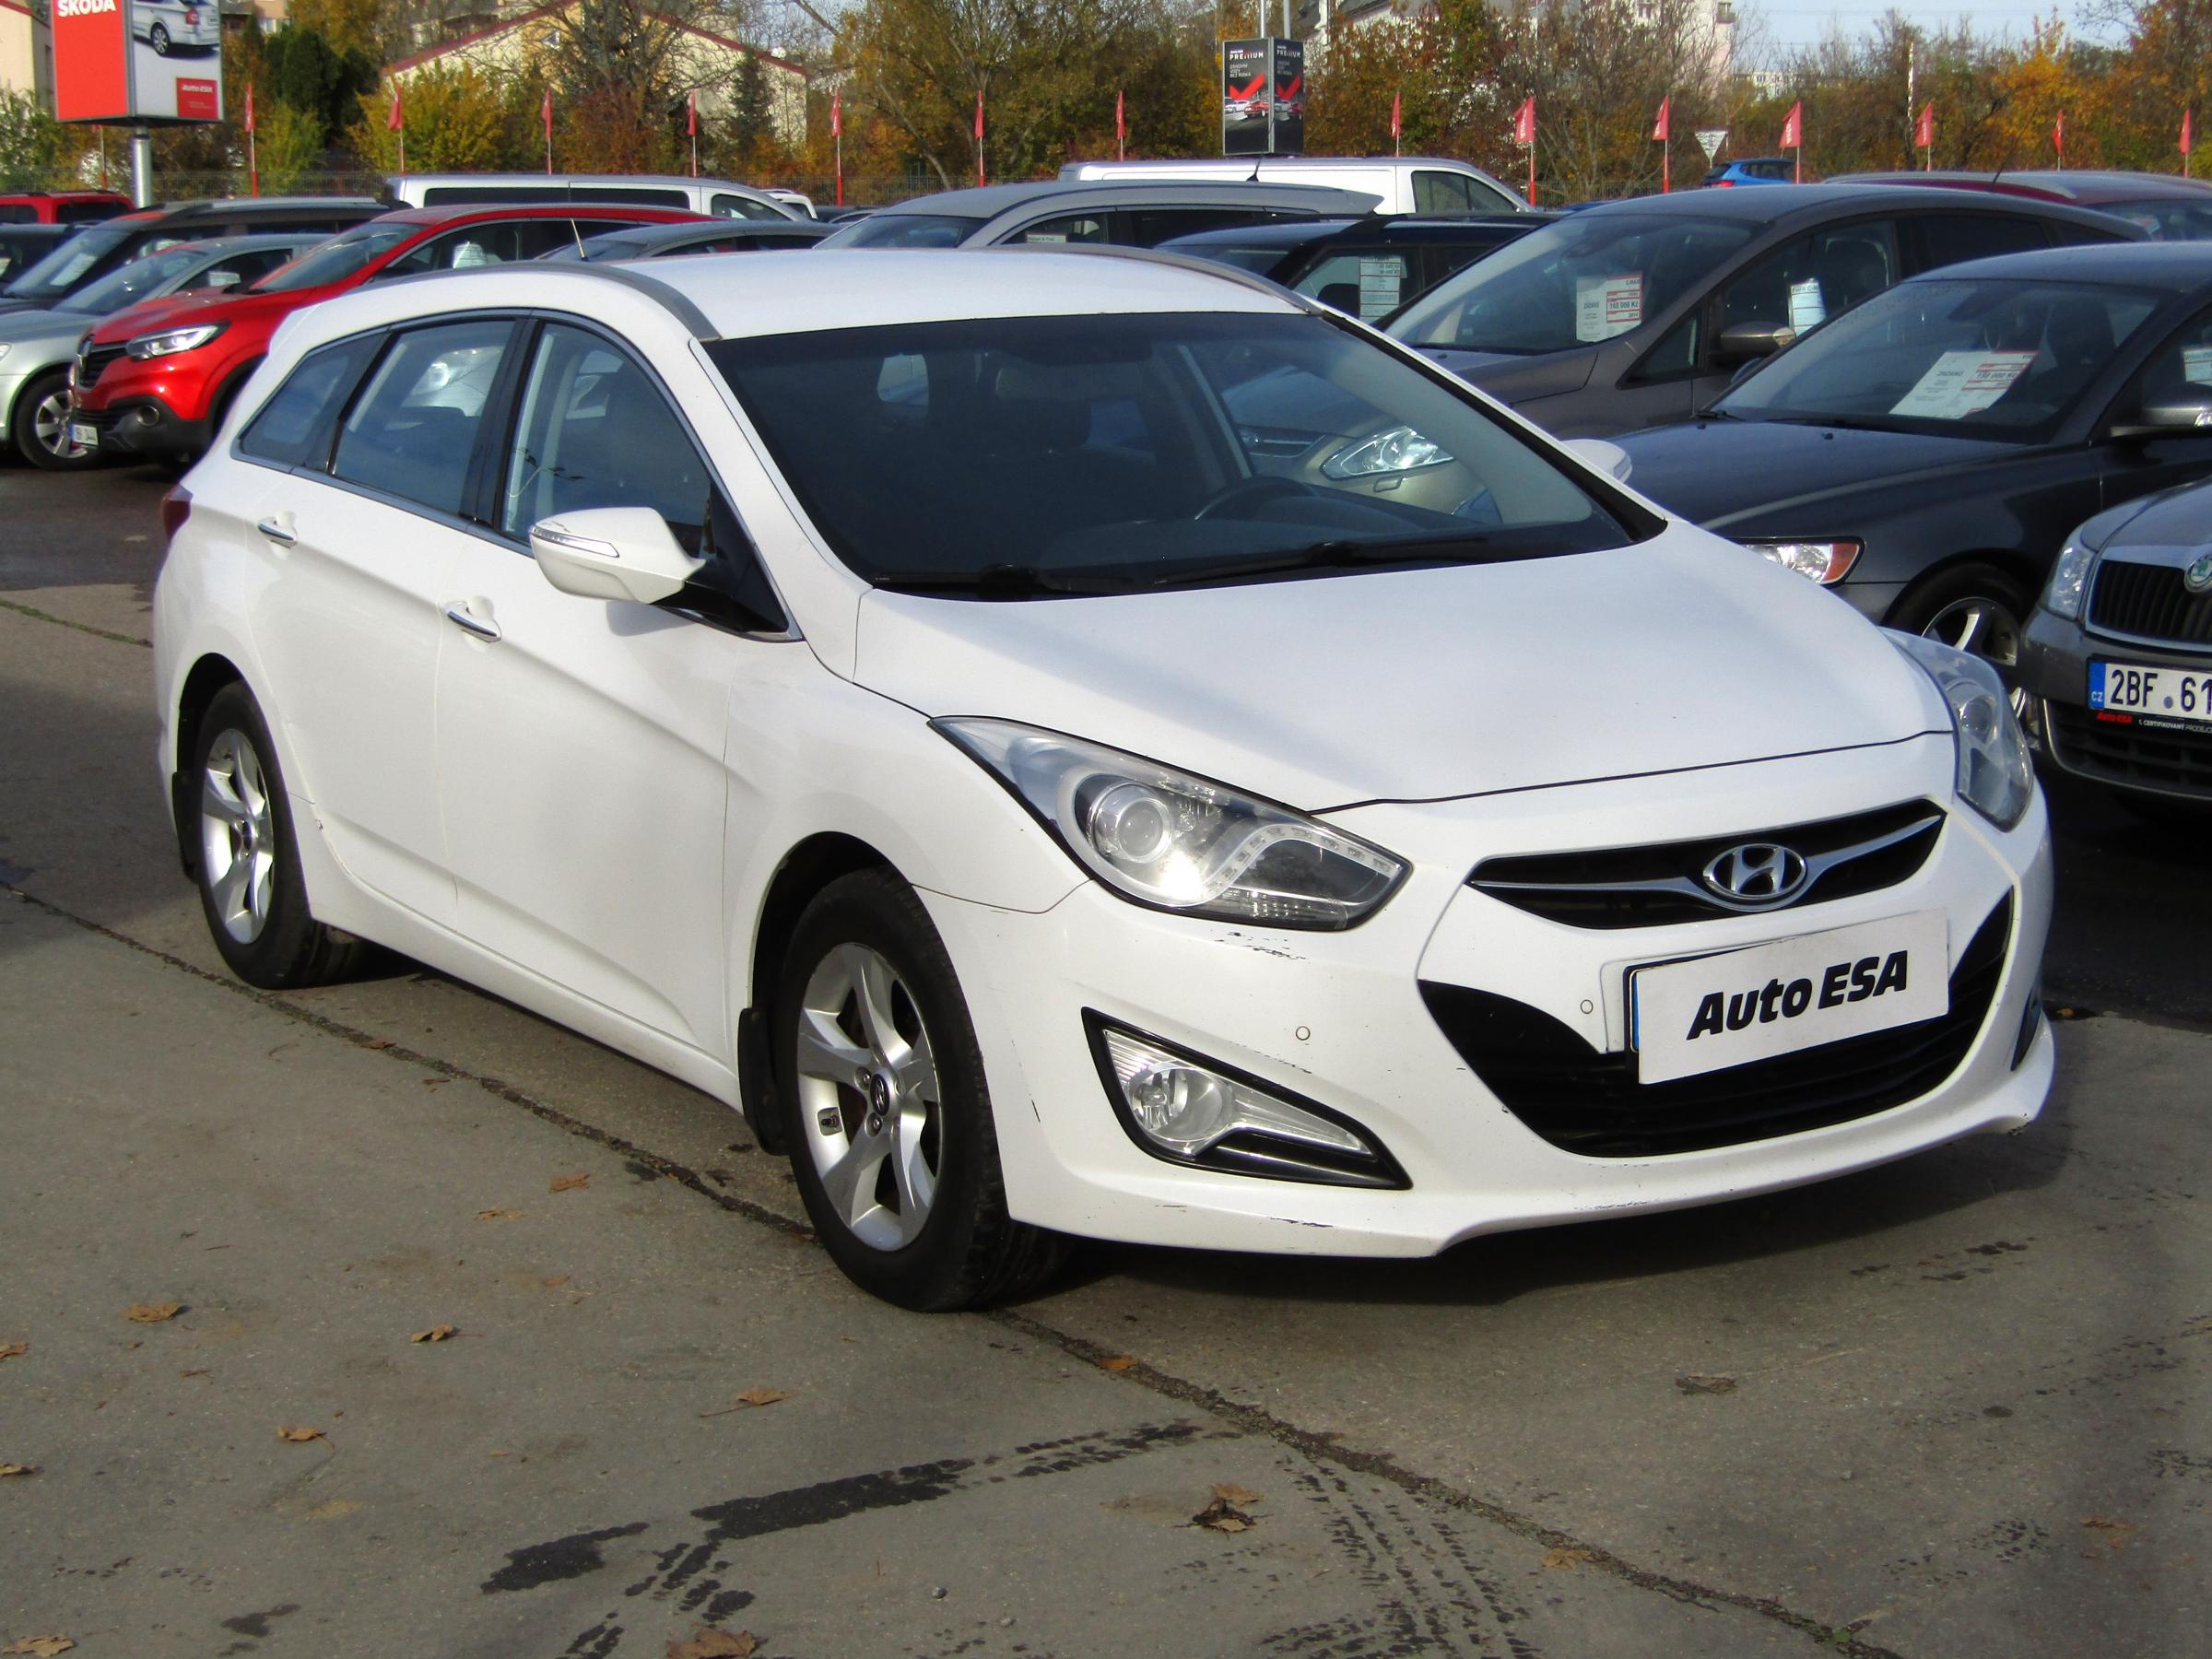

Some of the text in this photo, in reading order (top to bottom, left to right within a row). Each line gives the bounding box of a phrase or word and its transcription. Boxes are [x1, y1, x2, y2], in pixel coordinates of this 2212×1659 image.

[2091, 691, 2103, 702] CZ
[2110, 669, 2159, 708] 2BF
[1686, 949, 1908, 1041] Auto ESA
